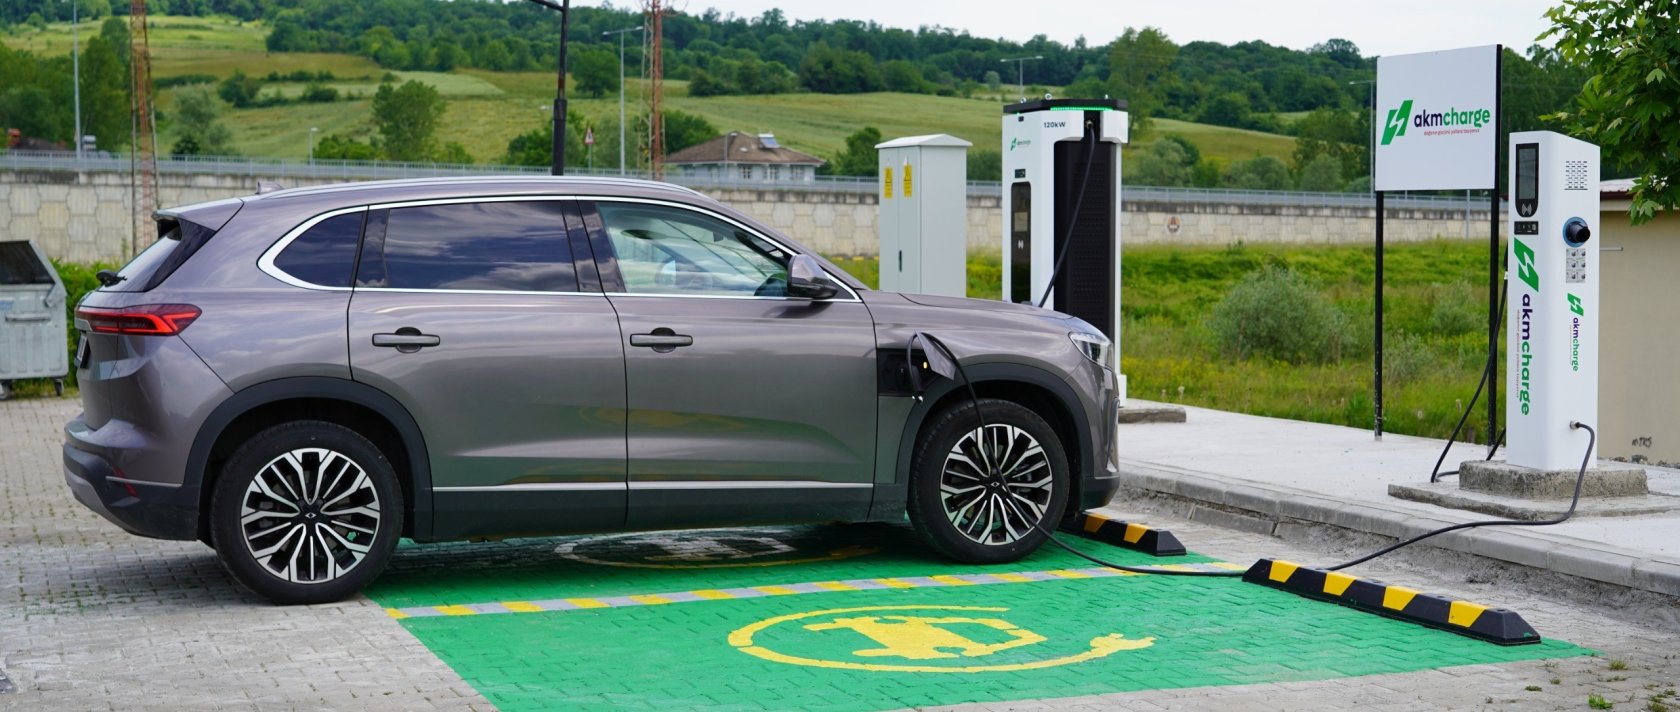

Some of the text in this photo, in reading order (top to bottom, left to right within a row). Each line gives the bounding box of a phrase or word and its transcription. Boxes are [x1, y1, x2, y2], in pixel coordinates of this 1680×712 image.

[1414, 107, 1490, 128] akmcharge
[1519, 293, 1533, 416] akmcharge
[1571, 317, 1580, 372] akmcharge
